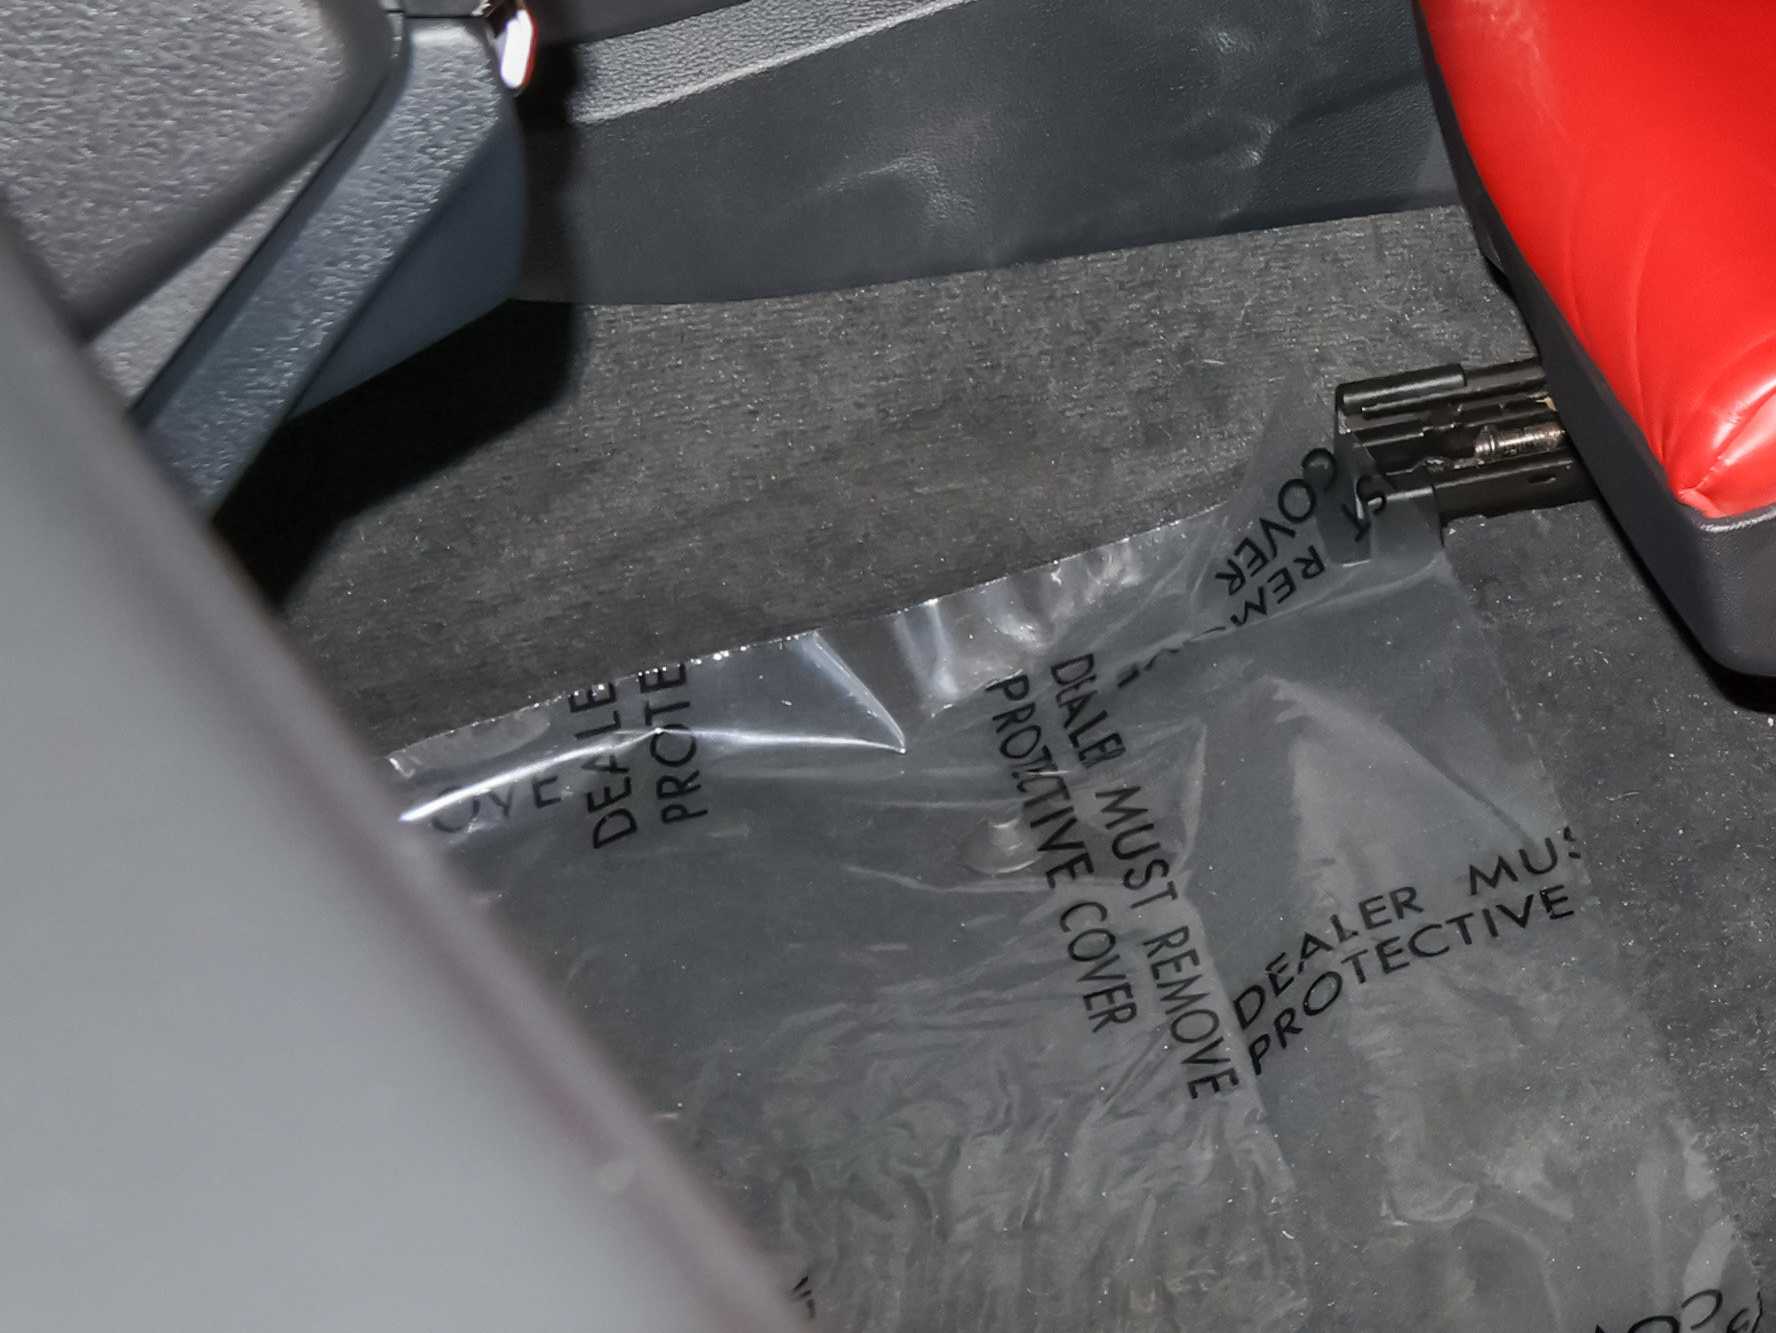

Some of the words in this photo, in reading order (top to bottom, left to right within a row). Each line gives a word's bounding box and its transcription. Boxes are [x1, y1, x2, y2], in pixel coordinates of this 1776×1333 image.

[1215, 447, 1337, 596] COVER
[1060, 901, 1137, 1033] COVER
[1095, 785, 1179, 909] MUST
[1142, 926, 1239, 1099] REMOVE
[1233, 885, 1424, 1030] DEALER
[1248, 884, 1575, 1076] PROTECTIVE
